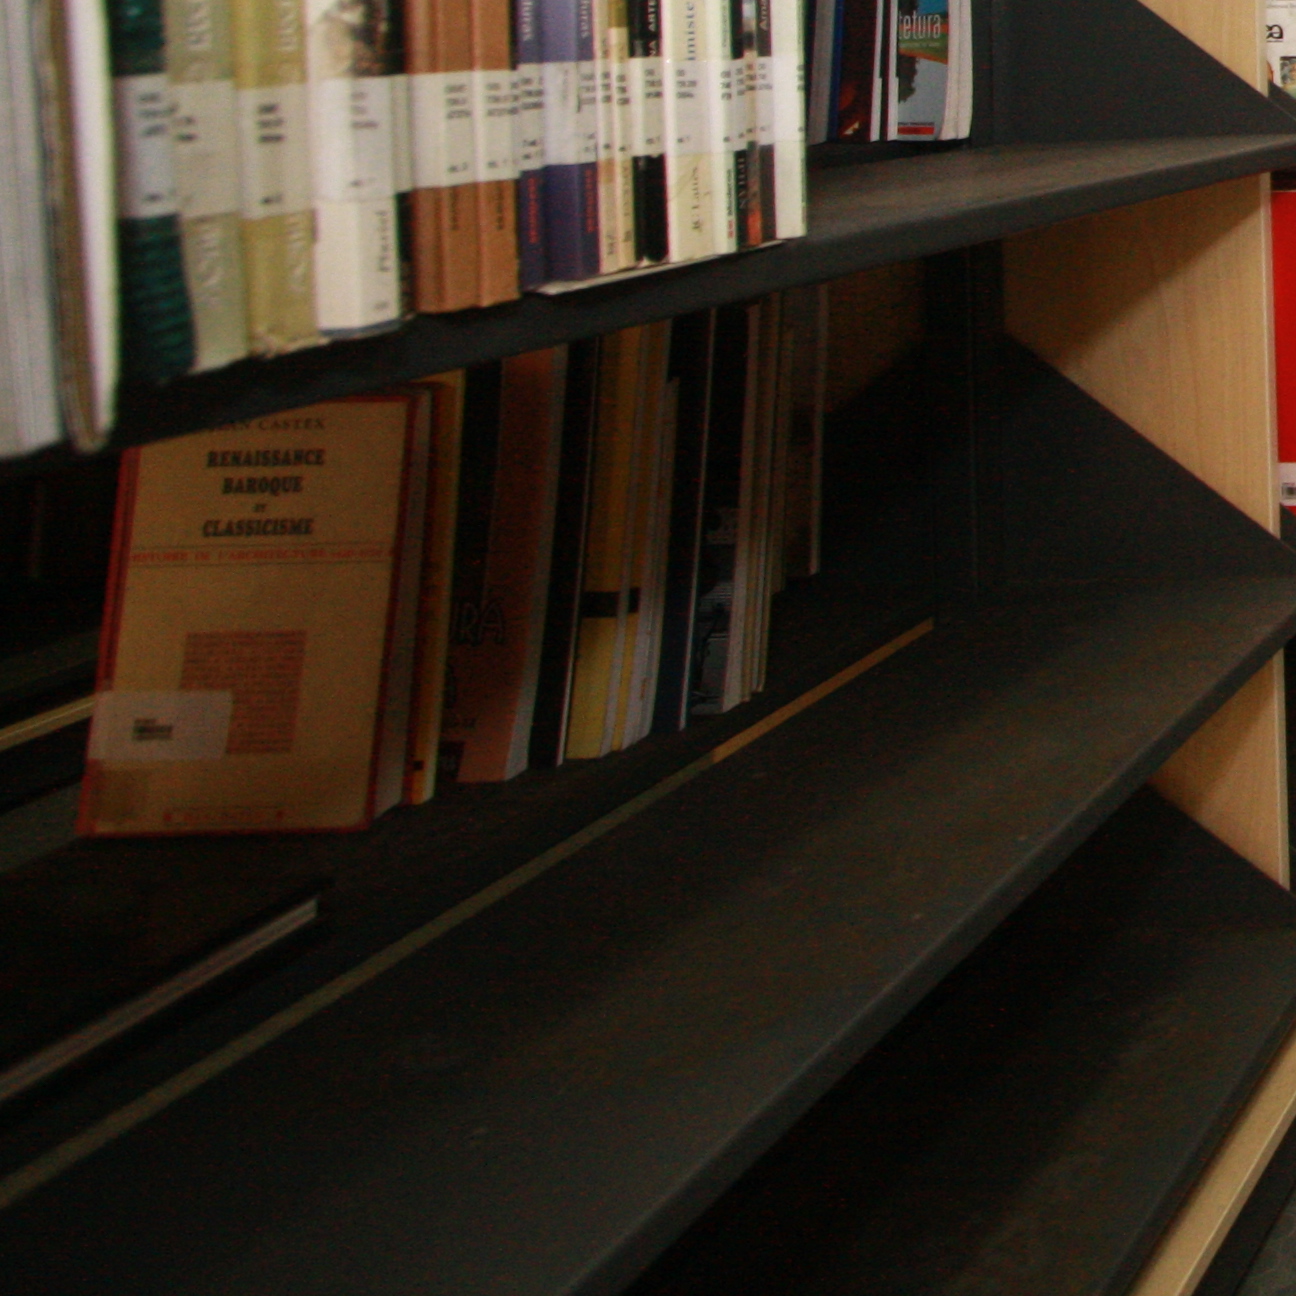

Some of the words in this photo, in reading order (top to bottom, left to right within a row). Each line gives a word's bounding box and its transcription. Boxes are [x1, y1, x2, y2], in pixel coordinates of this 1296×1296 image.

[257, 417, 325, 431] CASTEX
[206, 449, 325, 468] RENAISSANCE
[221, 476, 303, 495] BAROQUE
[202, 518, 315, 538] CLASSICISME
